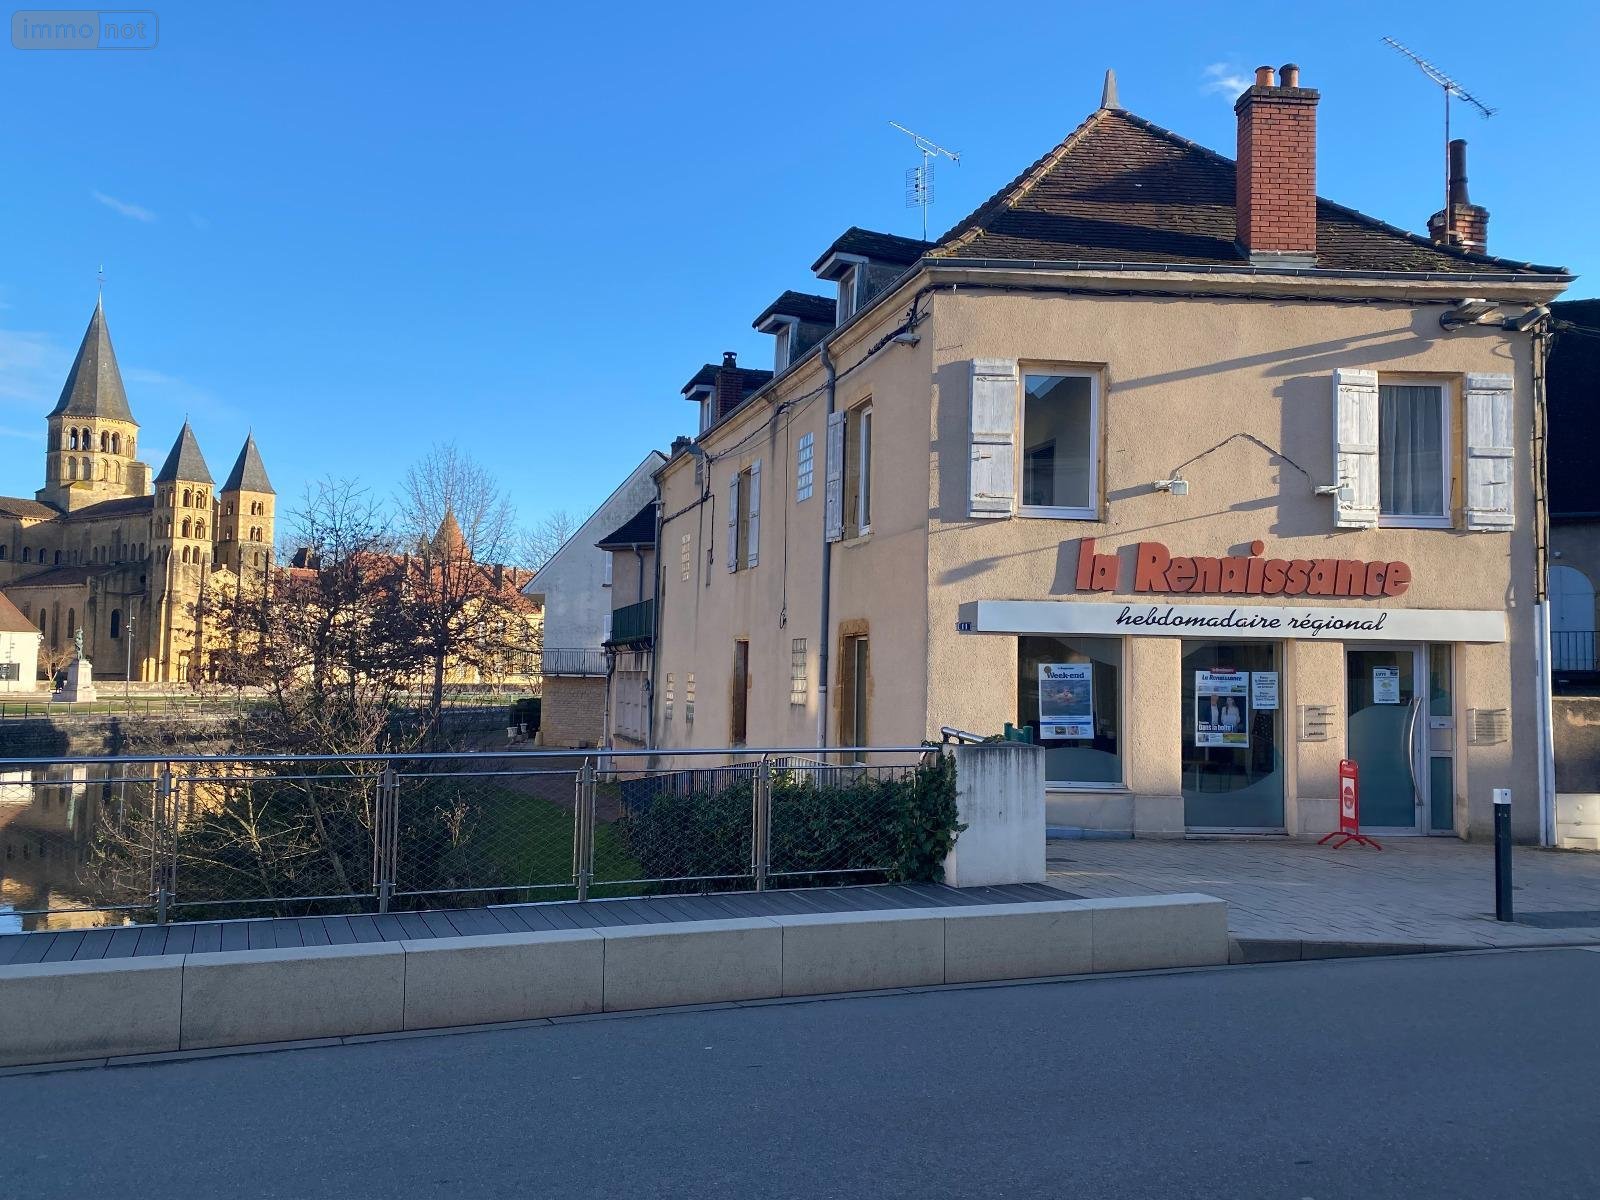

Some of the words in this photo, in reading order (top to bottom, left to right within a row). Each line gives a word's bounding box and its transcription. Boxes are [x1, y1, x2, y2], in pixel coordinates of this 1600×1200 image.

[1076, 537, 1120, 591] la
[1135, 540, 1412, 597] Renaissance
[1115, 606, 1282, 629] hebdomadaire
[1288, 612, 1388, 637] régional
